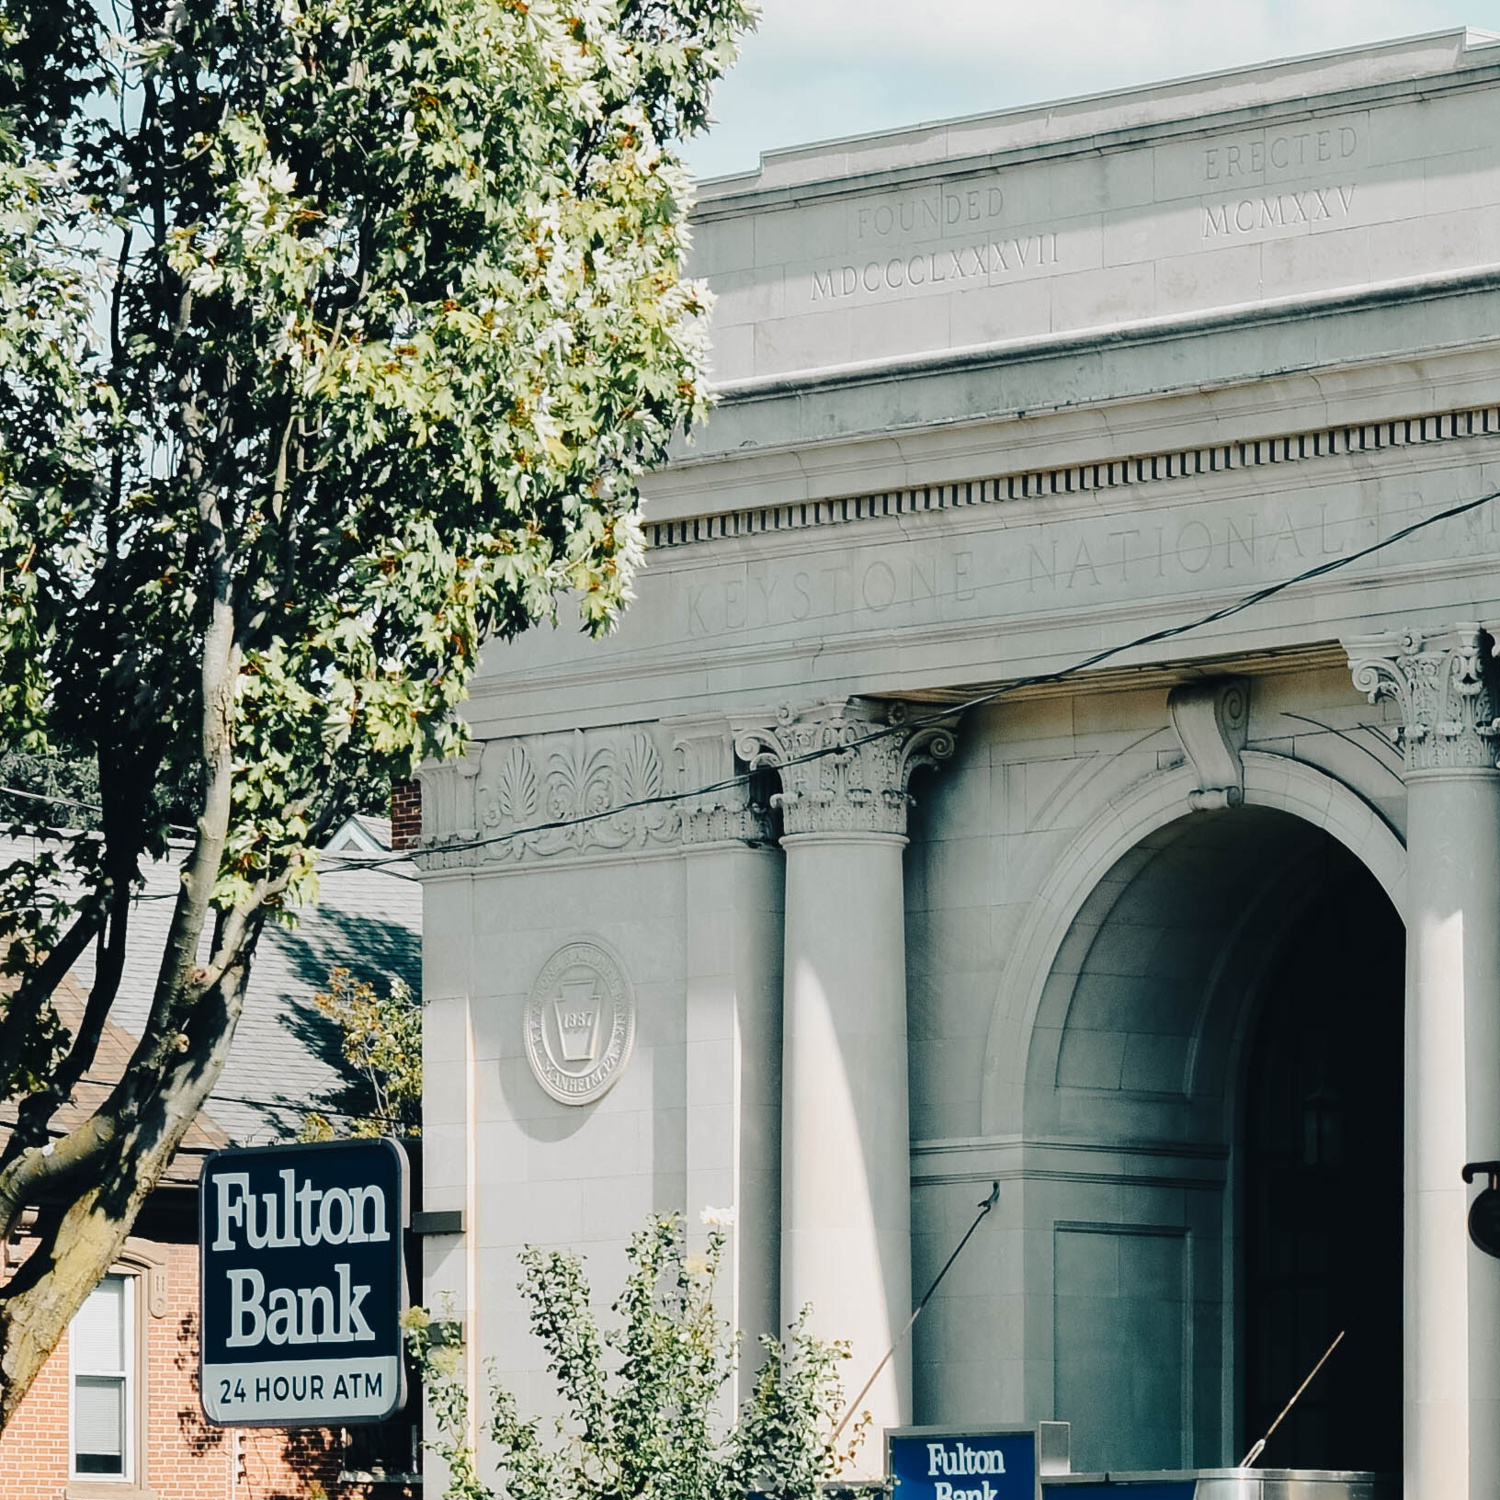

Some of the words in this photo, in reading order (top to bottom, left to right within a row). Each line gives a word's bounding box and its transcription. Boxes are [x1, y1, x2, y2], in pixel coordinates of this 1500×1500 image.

[1204, 126, 1357, 181] ERECTED
[856, 187, 1004, 240] FOUNDED
[1202, 183, 1357, 240] MCMXXV
[810, 232, 1059, 301] MDCCCLXXXVII
[683, 551, 976, 635] KEYSTONE
[1026, 502, 1345, 594] NATIONAL
[563, 1012, 594, 1029] 1887
[212, 1168, 391, 1251] Fulton
[226, 1263, 376, 1347] Bank
[220, 1378, 246, 1404] 24
[255, 1374, 324, 1402] HOUR
[333, 1372, 383, 1400] ATM
[926, 1442, 1006, 1477] Fulton
